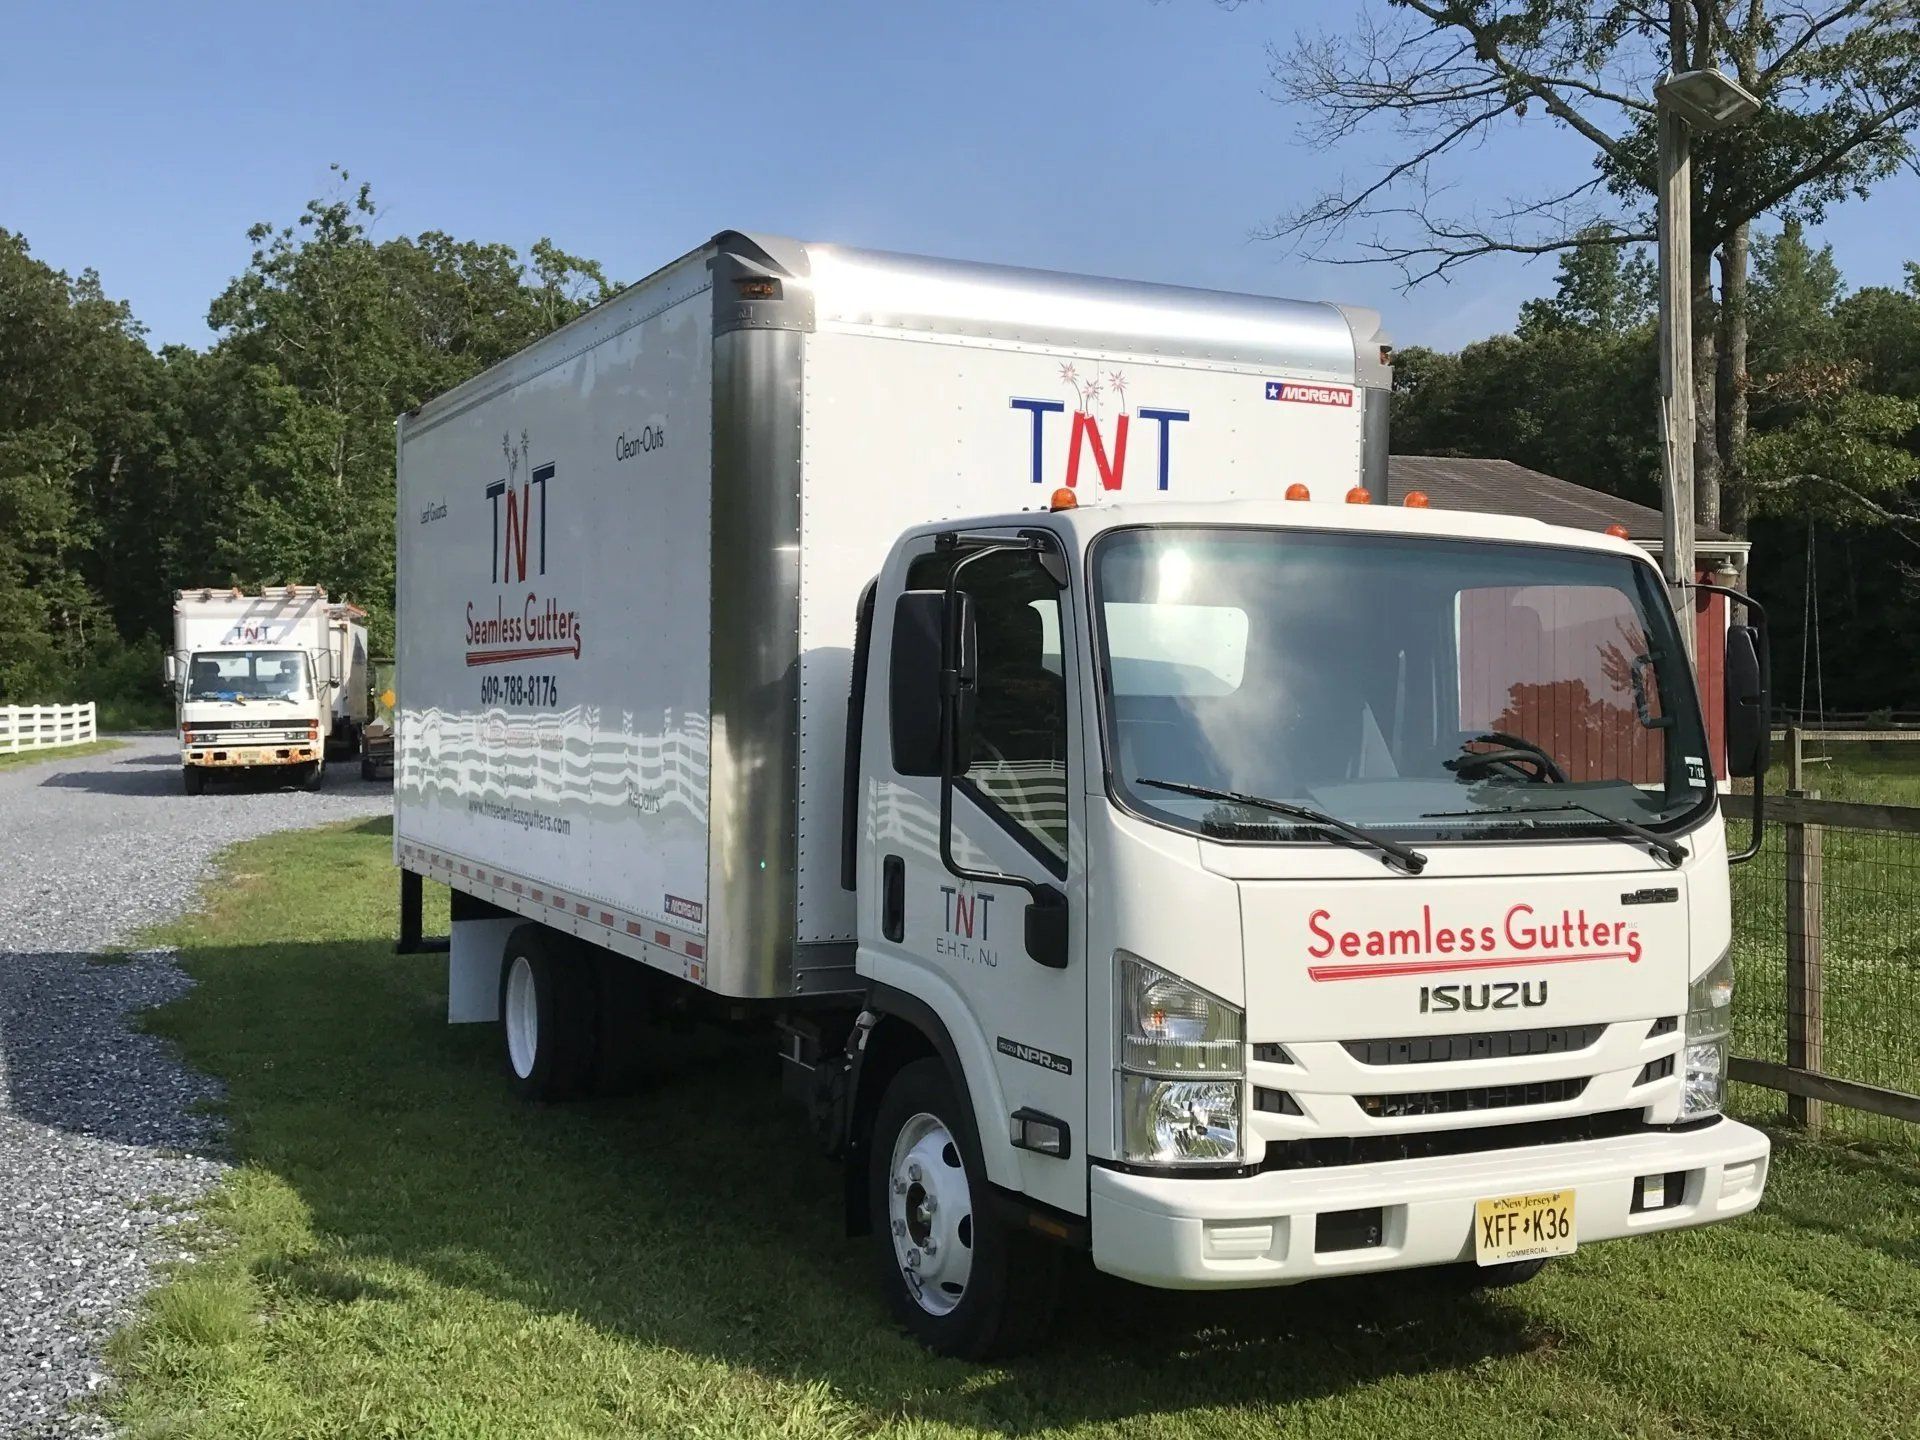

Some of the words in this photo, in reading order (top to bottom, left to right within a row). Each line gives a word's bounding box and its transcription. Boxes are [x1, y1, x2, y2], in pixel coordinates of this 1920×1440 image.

[1281, 385, 1350, 405] MORGAN
[616, 426, 664, 461] Clean-Outs
[1009, 396, 1190, 490] TNT
[486, 461, 555, 584] TNT
[234, 626, 271, 640] TNT
[466, 595, 521, 645] Seamless
[524, 592, 581, 660] Gutters
[481, 675, 557, 707] 609-788-8176
[231, 720, 271, 729] ISUZU
[627, 780, 661, 816] Repairs
[670, 900, 701, 920] MORGAN
[940, 885, 994, 941] TNT
[1308, 904, 1496, 958] Seamless
[1505, 902, 1642, 963] Gutters
[936, 938, 975, 963] E.H.T.,
[979, 948, 998, 967] NJ
[1419, 980, 1548, 1014] ISUZU
[1501, 1198, 1521, 1210] New
[1523, 1196, 1552, 1209] Jersey
[1483, 1212, 1519, 1249] XFF
[1533, 1207, 1569, 1242] K36
[1506, 1247, 1548, 1258] COMMERCIAL
